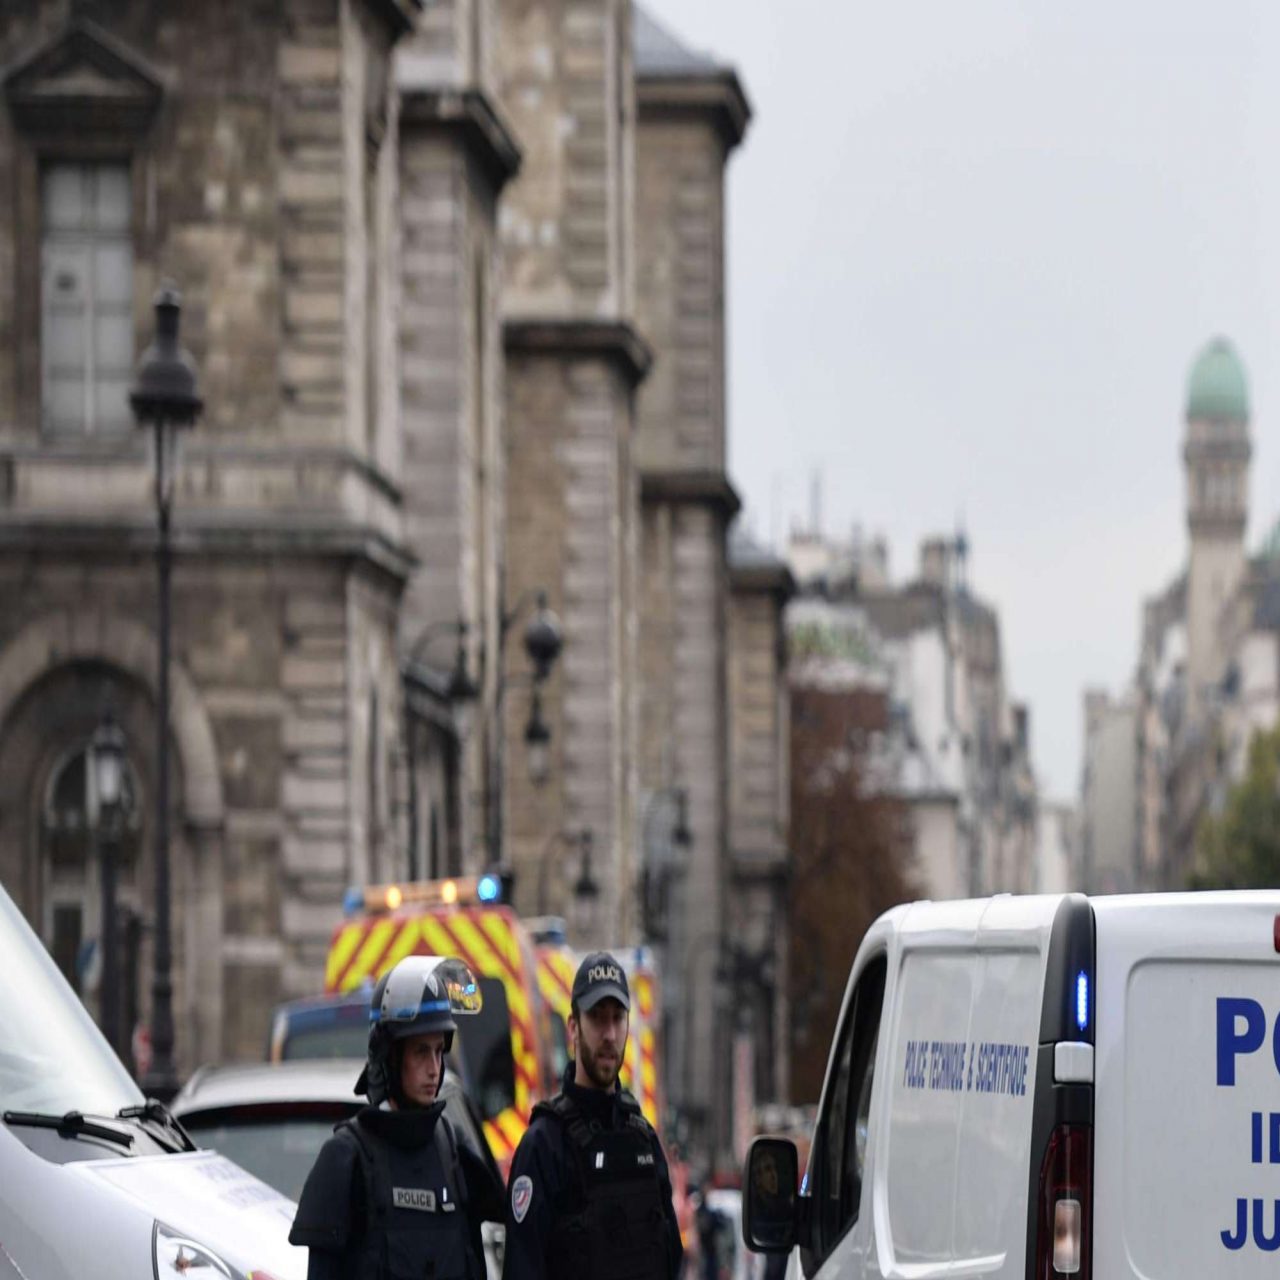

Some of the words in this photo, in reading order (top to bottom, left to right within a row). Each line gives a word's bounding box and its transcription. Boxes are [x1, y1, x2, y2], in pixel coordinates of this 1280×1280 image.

[588, 964, 622, 984] POLICE
[903, 1041, 928, 1089] POLICE
[928, 1041, 966, 1092] TECHNIQUE
[976, 1042, 1029, 1097] SCIENTIFIQUE
[397, 1190, 432, 1208] POLICE
